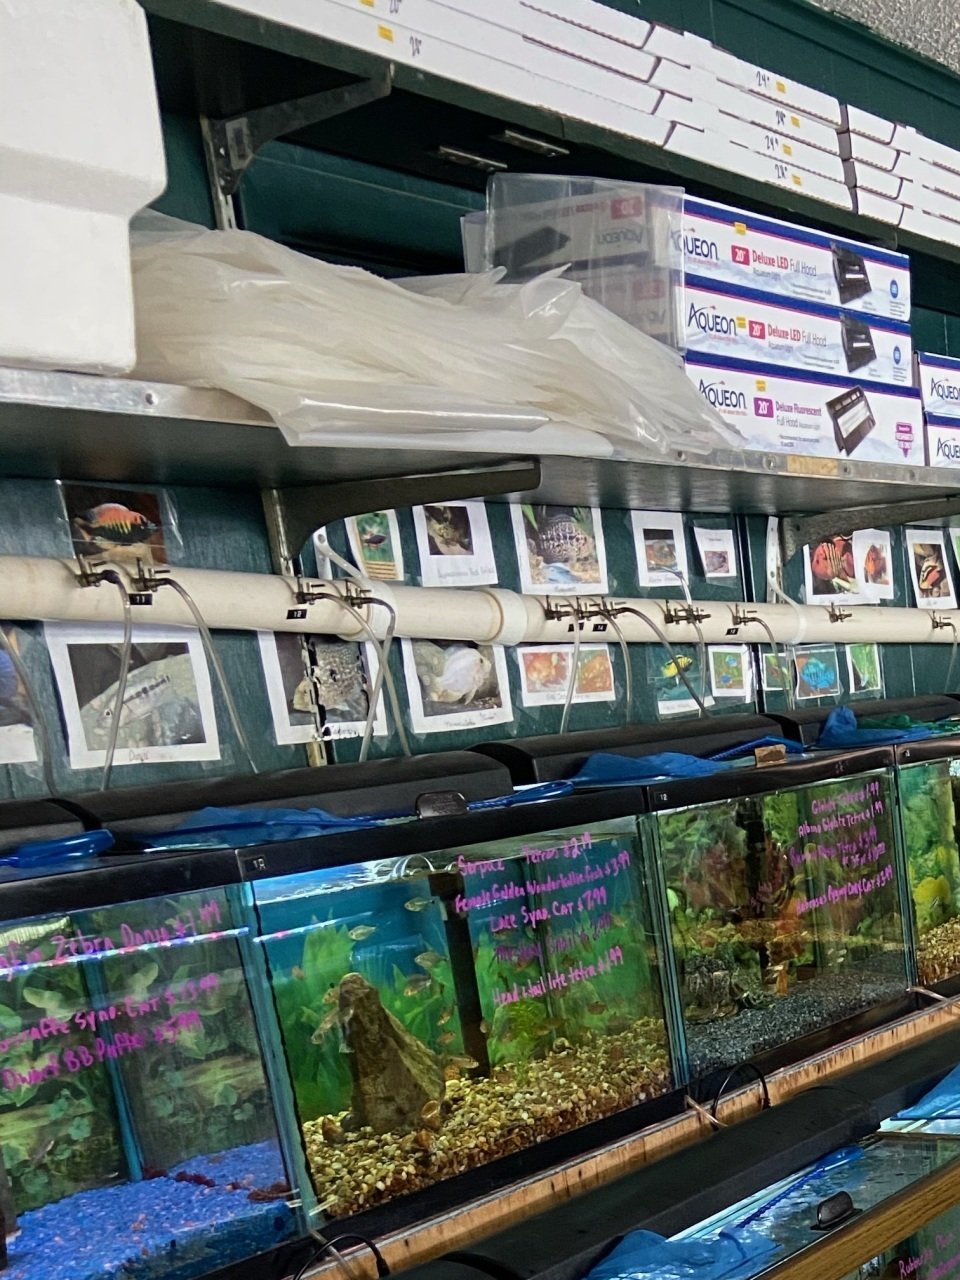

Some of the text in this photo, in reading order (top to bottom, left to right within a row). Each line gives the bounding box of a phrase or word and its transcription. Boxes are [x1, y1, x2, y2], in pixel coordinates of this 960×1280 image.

[752, 250, 776, 267] Deluxe
[777, 256, 789, 270] LED
[768, 324, 789, 341] Deluxe
[790, 329, 801, 342] LED
[63, 1045, 93, 1073] BB
